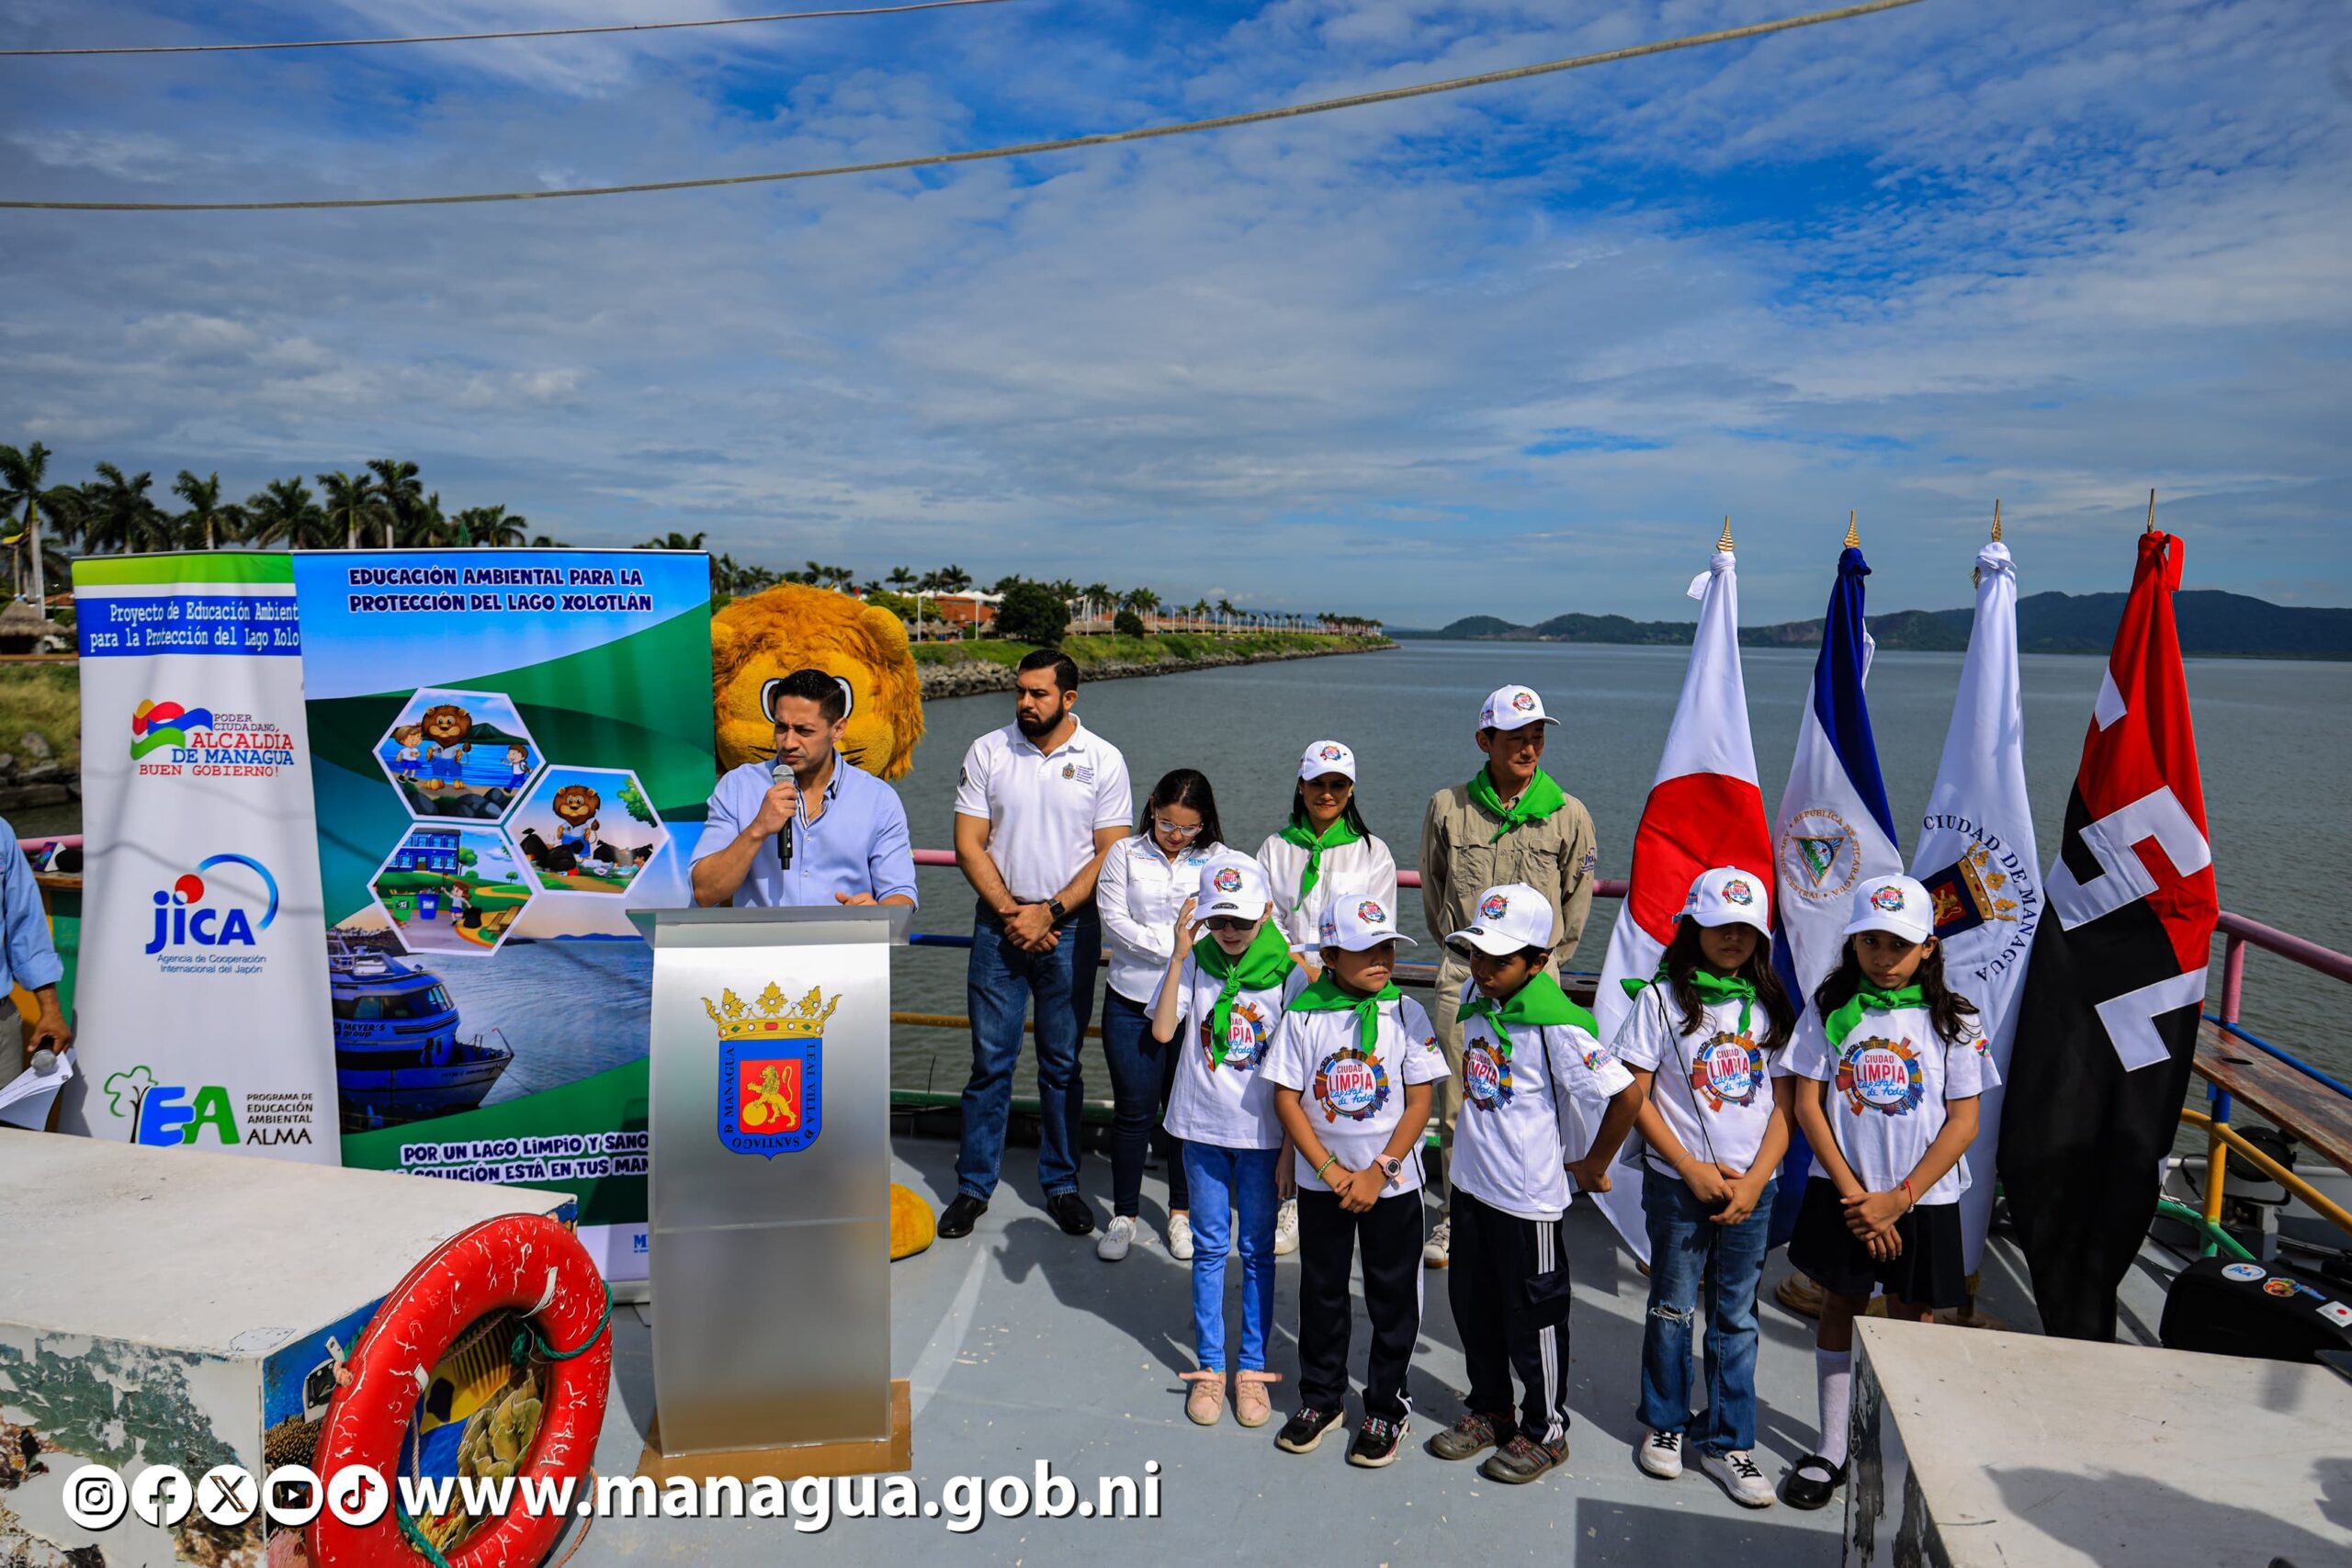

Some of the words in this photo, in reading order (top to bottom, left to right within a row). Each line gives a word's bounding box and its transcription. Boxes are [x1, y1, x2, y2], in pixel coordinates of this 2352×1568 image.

[349, 566, 458, 585] EDUCACIÓN
[463, 568, 564, 585] AMBIENTAL
[569, 570, 616, 585] PARA
[620, 570, 644, 586] LA
[349, 592, 466, 612] PROTECCIÓN
[470, 594, 503, 611] DEL
[507, 594, 555, 611] LAGO
[560, 592, 652, 611] XOLOTLÁN
[110, 604, 164, 626] Proyecto
[166, 601, 179, 621] de
[186, 601, 251, 621] Educación
[90, 632, 119, 653] para
[126, 627, 141, 647] la
[145, 626, 209, 647] Protección
[214, 626, 238, 646] del
[244, 627, 269, 651] Lago
[213, 714, 252, 723] PODER
[172, 749, 198, 763] DE
[205, 749, 294, 765] MANAGUA
[139, 764, 183, 775] BUEN
[192, 765, 279, 777] GOBIERNO!
[1923, 815, 2000, 852] CIUDAD
[2000, 852, 2028, 885] DE
[1973, 886, 2038, 982] MANAGUA
[157, 954, 193, 964] Agencia
[195, 954, 207, 963] de
[209, 953, 266, 964] Cooperación
[160, 964, 215, 973] Internacional
[219, 964, 232, 973] del
[234, 964, 263, 975] Japón
[1865, 1055, 1894, 1064] CIUDAD
[1337, 1065, 1363, 1074] CIUDAD
[1856, 1065, 1905, 1084] LIMPIA
[724, 1047, 735, 1118] MANAGUA
[1329, 1073, 1374, 1091] LIMPIA
[246, 1093, 299, 1101] PROGRAMA
[247, 1101, 313, 1112] EDUCACIÓN
[247, 1114, 312, 1124] AMBIENTAL
[246, 1128, 312, 1145] ALMA
[732, 1136, 801, 1149] SANTIAGO
[403, 1145, 437, 1162] POR
[443, 1145, 468, 1160] UN
[473, 1141, 517, 1157] LAGO
[588, 1136, 599, 1151] Y
[605, 1133, 648, 1150] SANO
[505, 1160, 546, 1179] ESTÁ
[551, 1162, 571, 1177] EN
[577, 1159, 609, 1176] TUS
